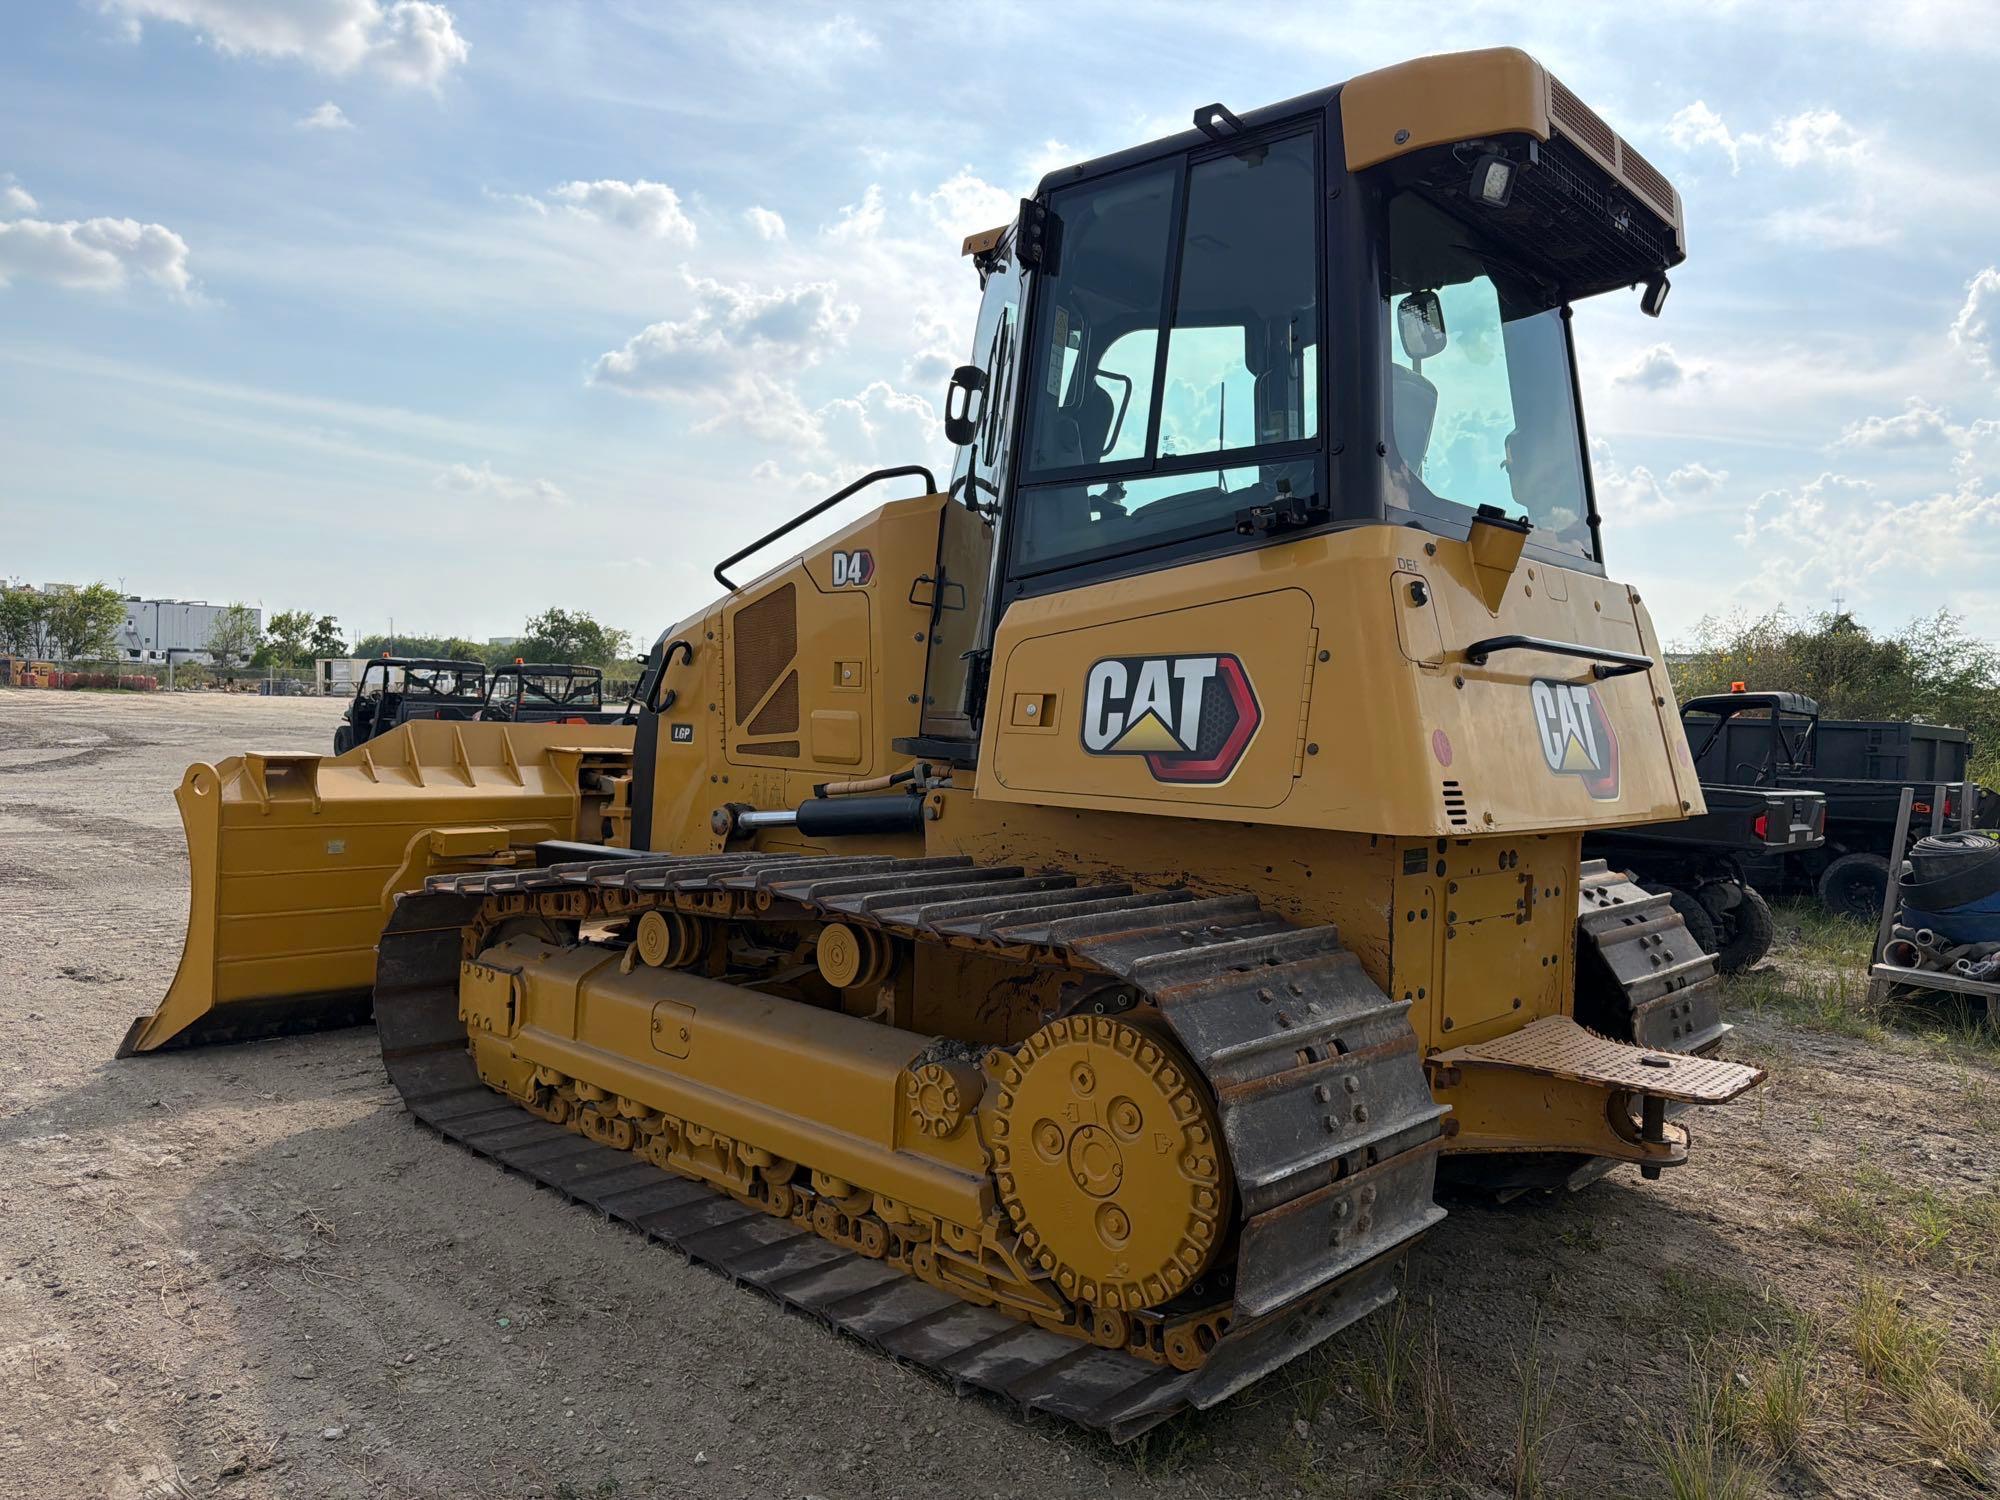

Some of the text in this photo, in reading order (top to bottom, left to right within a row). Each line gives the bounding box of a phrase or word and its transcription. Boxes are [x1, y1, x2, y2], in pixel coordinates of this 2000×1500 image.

[833, 552, 862, 585] D4
[1397, 556, 1419, 572] DEF
[1084, 657, 1218, 751] CAT
[674, 727, 691, 740] LGP
[1531, 680, 1601, 770] CAT
